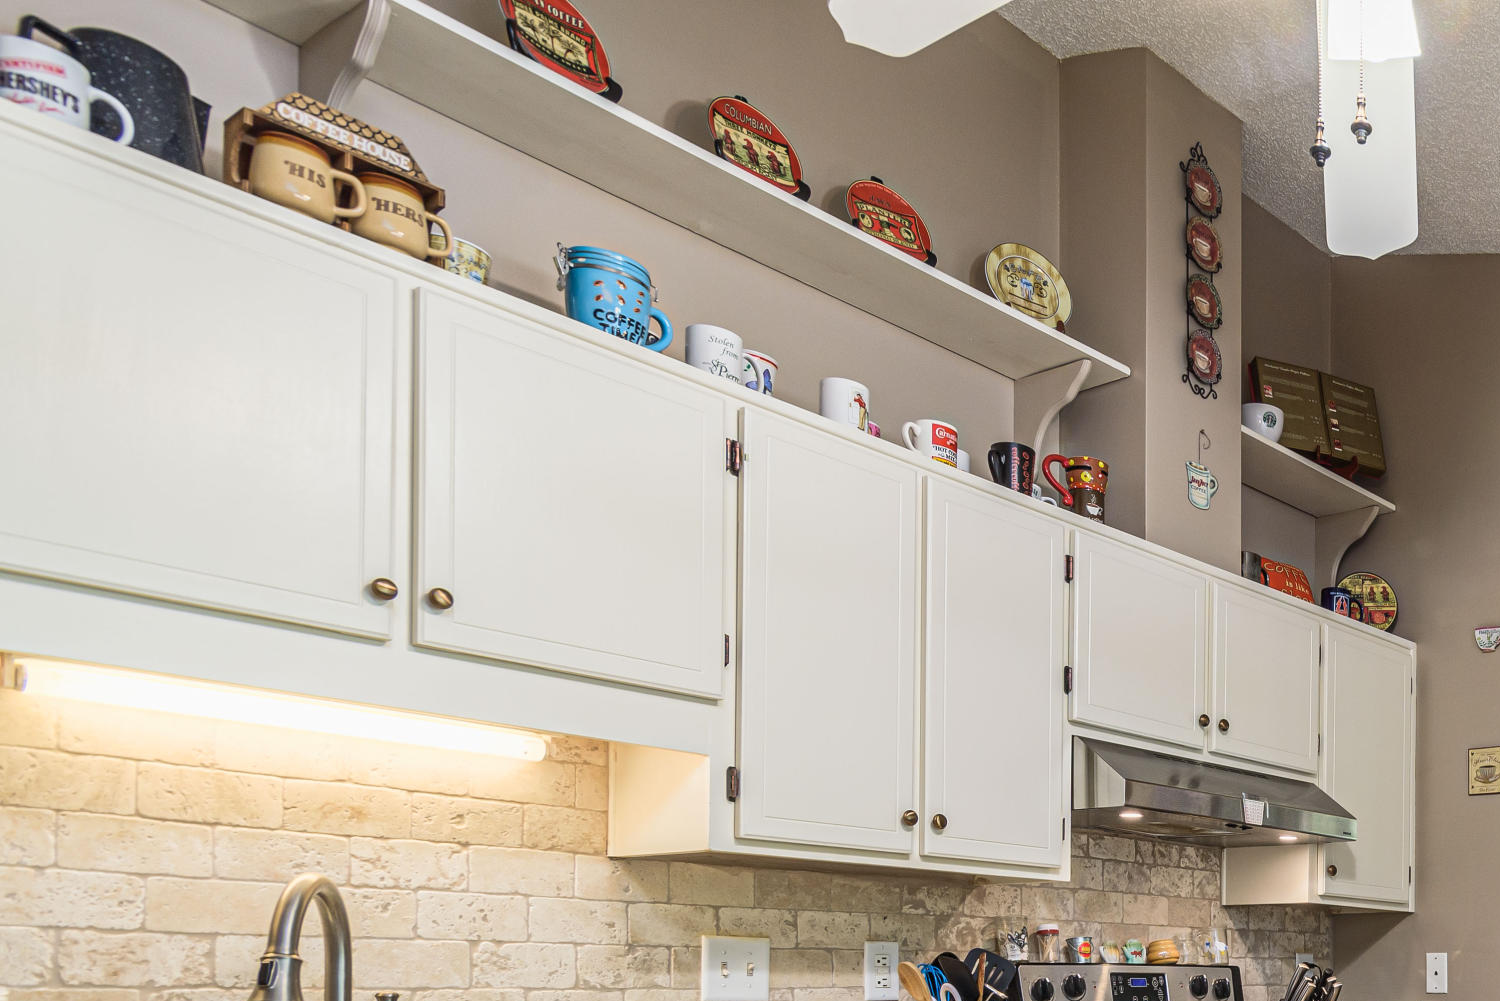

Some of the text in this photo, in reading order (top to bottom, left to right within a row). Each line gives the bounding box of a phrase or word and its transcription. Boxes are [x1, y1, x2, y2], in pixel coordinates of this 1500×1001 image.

[547, 4, 585, 30] COFFEE
[724, 103, 773, 136] COLUMBIAN
[277, 102, 412, 172] COFFEE HOUSE
[284, 160, 327, 190] HIS
[372, 196, 425, 229] HERS
[593, 308, 647, 339] COFFEE
[708, 335, 735, 349] Stolen
[721, 347, 739, 360] from
